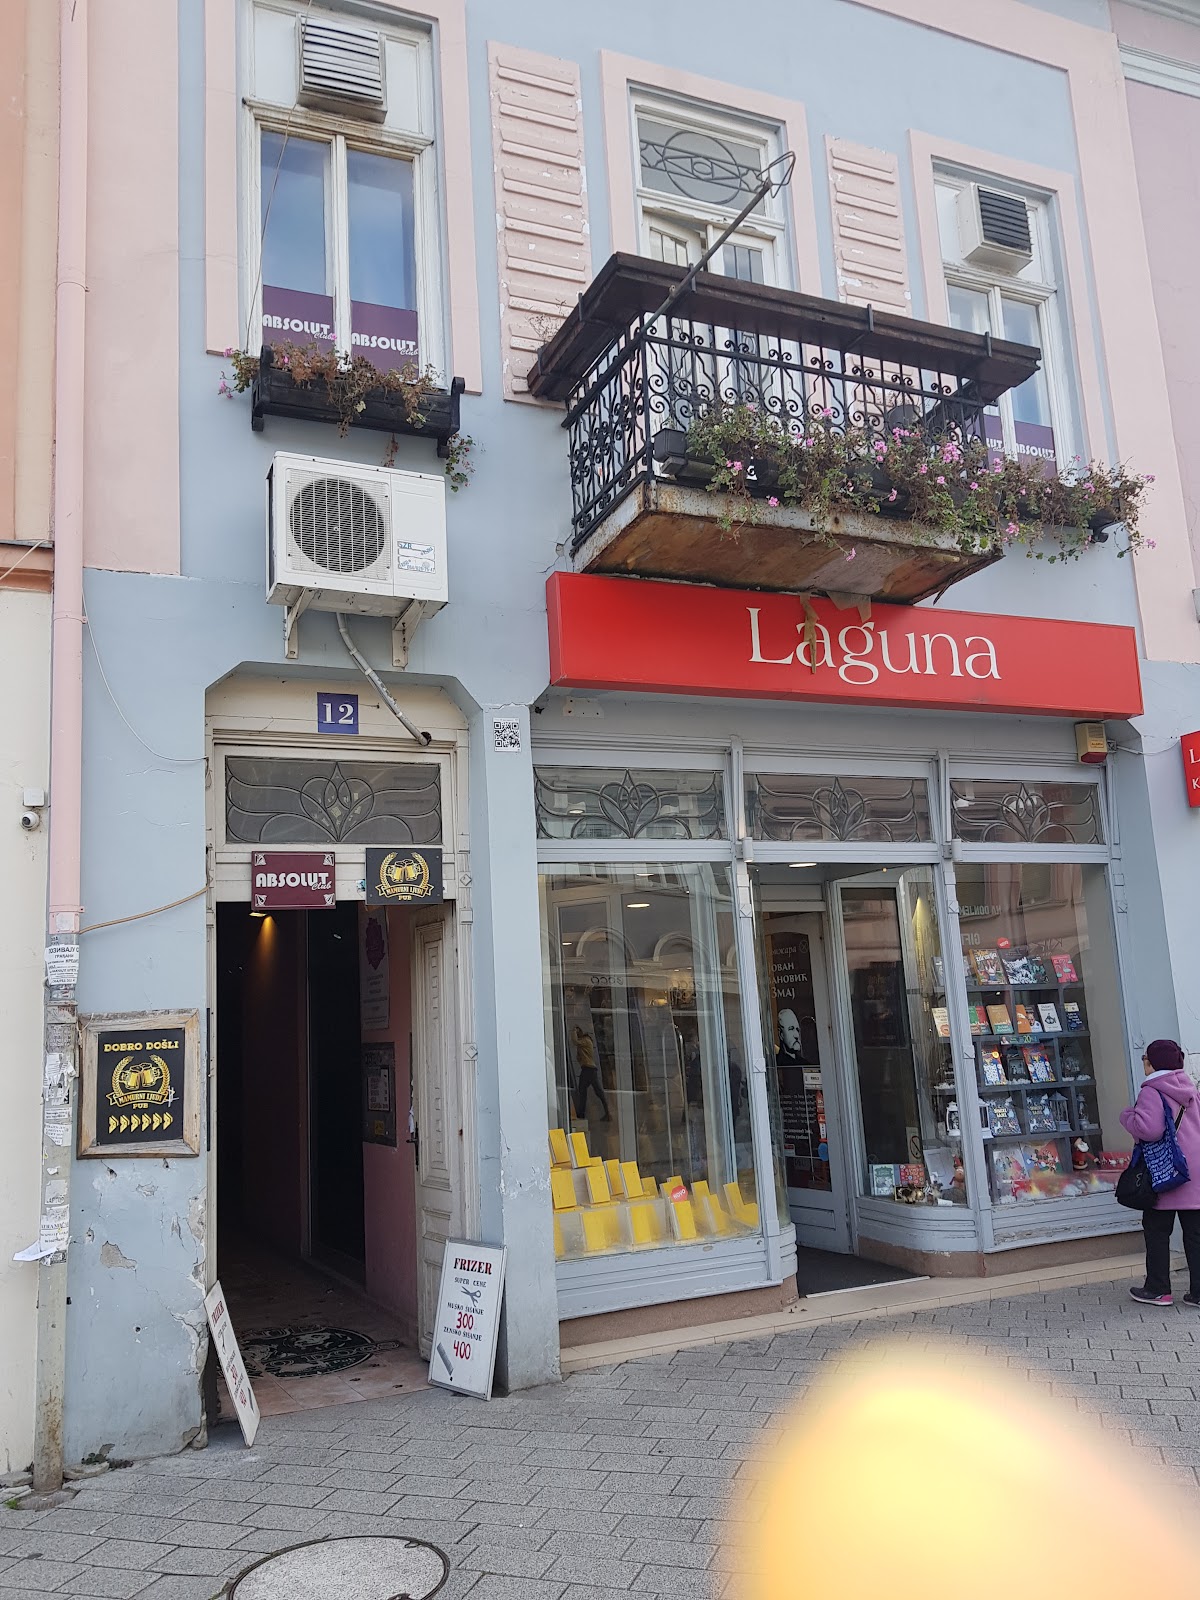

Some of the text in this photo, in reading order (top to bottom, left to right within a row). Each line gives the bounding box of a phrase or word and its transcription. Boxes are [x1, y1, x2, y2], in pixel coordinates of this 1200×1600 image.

[262, 313, 331, 335] ABSOLUT
[351, 332, 417, 352] ABSOLUT
[746, 607, 1002, 685] Laguna
[322, 702, 354, 725] 12
[255, 872, 330, 888] ABSOLUT
[311, 880, 333, 891] Club
[771, 962, 795, 973] ОВАН
[103, 1039, 179, 1052] DOBRO DOŠLI
[118, 1093, 146, 1104] MAMURNI
[453, 1257, 493, 1275] FRIZER
[456, 1311, 474, 1330] 300
[453, 1339, 471, 1360] 400
